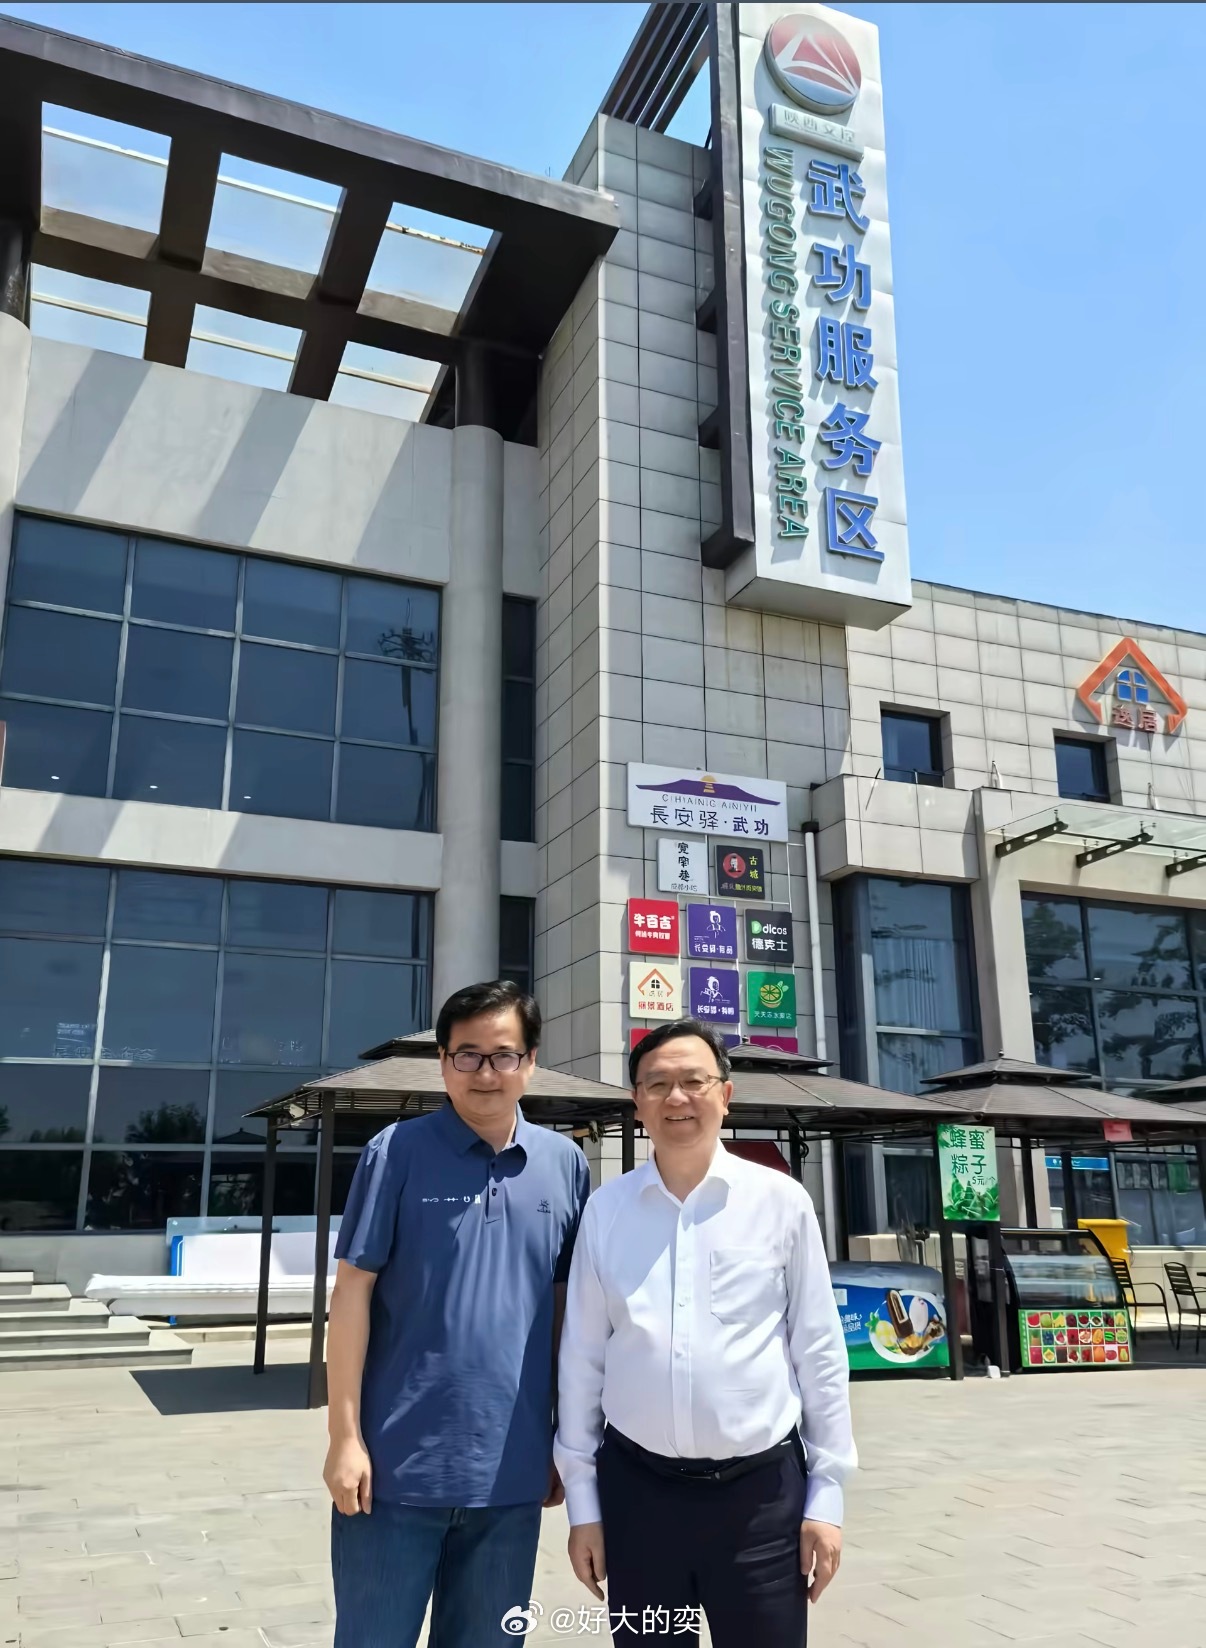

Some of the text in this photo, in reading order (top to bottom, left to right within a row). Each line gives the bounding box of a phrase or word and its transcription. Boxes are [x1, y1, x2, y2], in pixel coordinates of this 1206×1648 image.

[764, 146, 810, 538] WUGONG SERVICE AREA
[806, 158, 885, 562] 武功服务区
[748, 855, 759, 879] 古城
[751, 938, 788, 951] 德克士
[950, 1129, 985, 1150] 蜂蜜
[951, 1153, 987, 1175] 粽子
